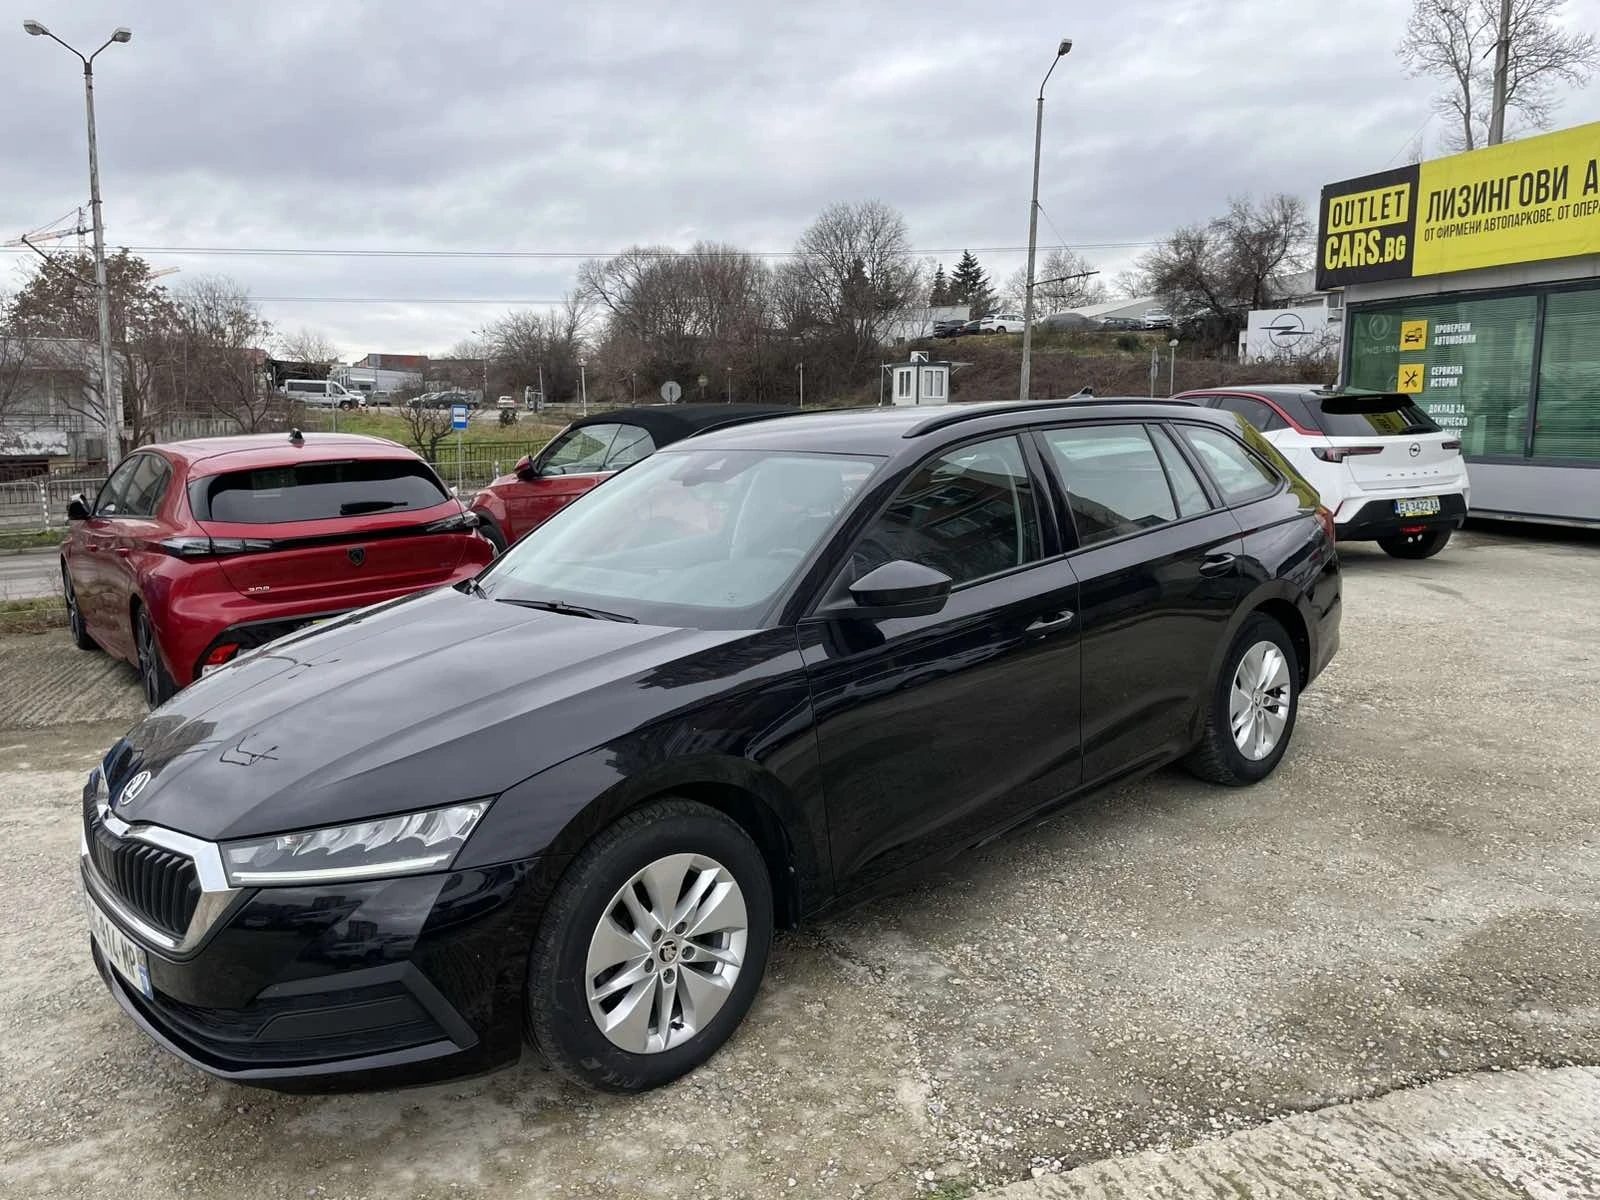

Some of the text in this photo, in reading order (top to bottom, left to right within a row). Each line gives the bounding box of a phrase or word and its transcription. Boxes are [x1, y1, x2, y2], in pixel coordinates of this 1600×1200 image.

[1333, 190, 1405, 228] OUTLET
[1426, 165, 1569, 224] ЛИЗИНГОВИ
[1424, 228, 1436, 242] ОТ
[1436, 224, 1482, 239] ФИРМЕНИ
[1557, 204, 1571, 220] ОТ
[1573, 199, 1600, 218] ОПЕР
[1325, 230, 1406, 270] CARS.BG
